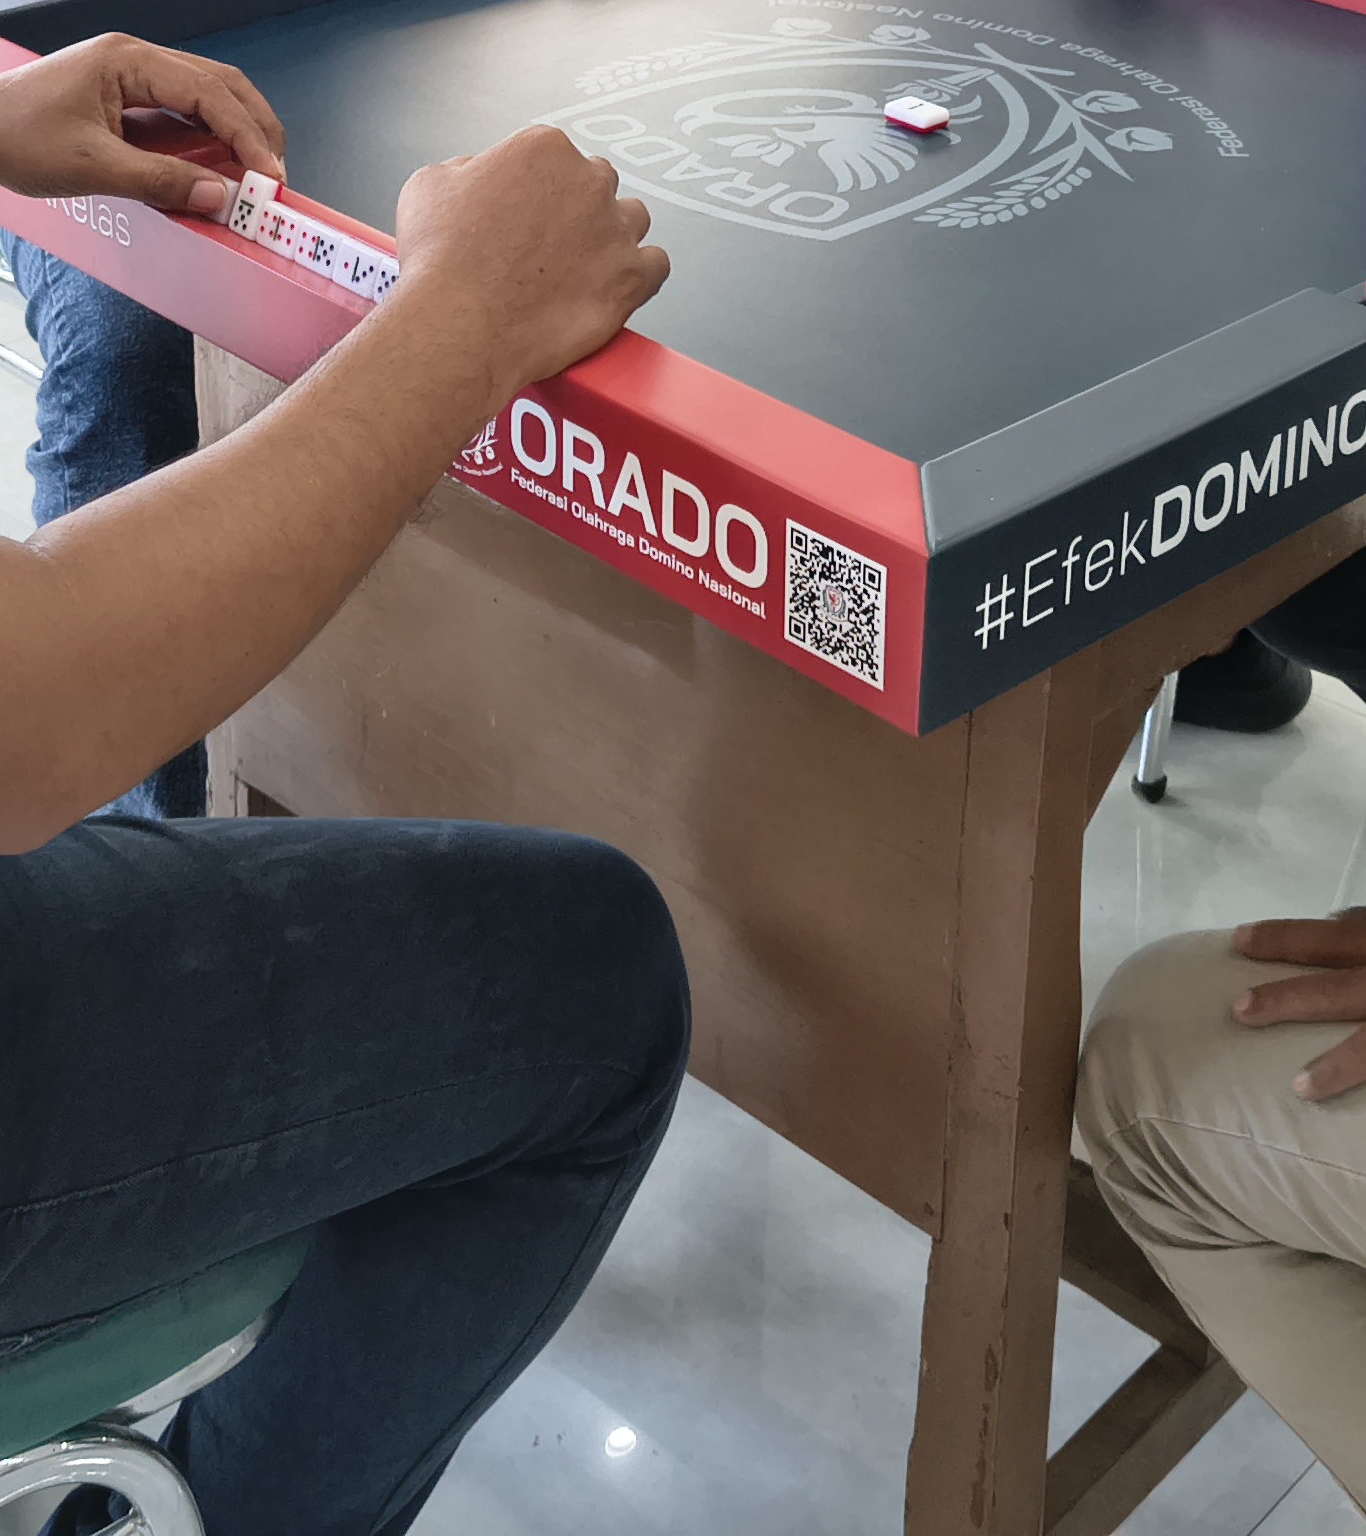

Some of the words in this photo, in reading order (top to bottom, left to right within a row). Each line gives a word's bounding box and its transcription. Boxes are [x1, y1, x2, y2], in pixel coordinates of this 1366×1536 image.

[933, 13, 1055, 45] Domino
[1059, 42, 1180, 94] Olahraga
[571, 114, 850, 223] ORADO
[1168, 96, 1250, 157] Federasi
[509, 398, 769, 589] ORADO
[511, 467, 568, 512] Federasi
[571, 501, 635, 547] Olahraga
[638, 536, 695, 579] Domino
[698, 568, 767, 620] Nasional
